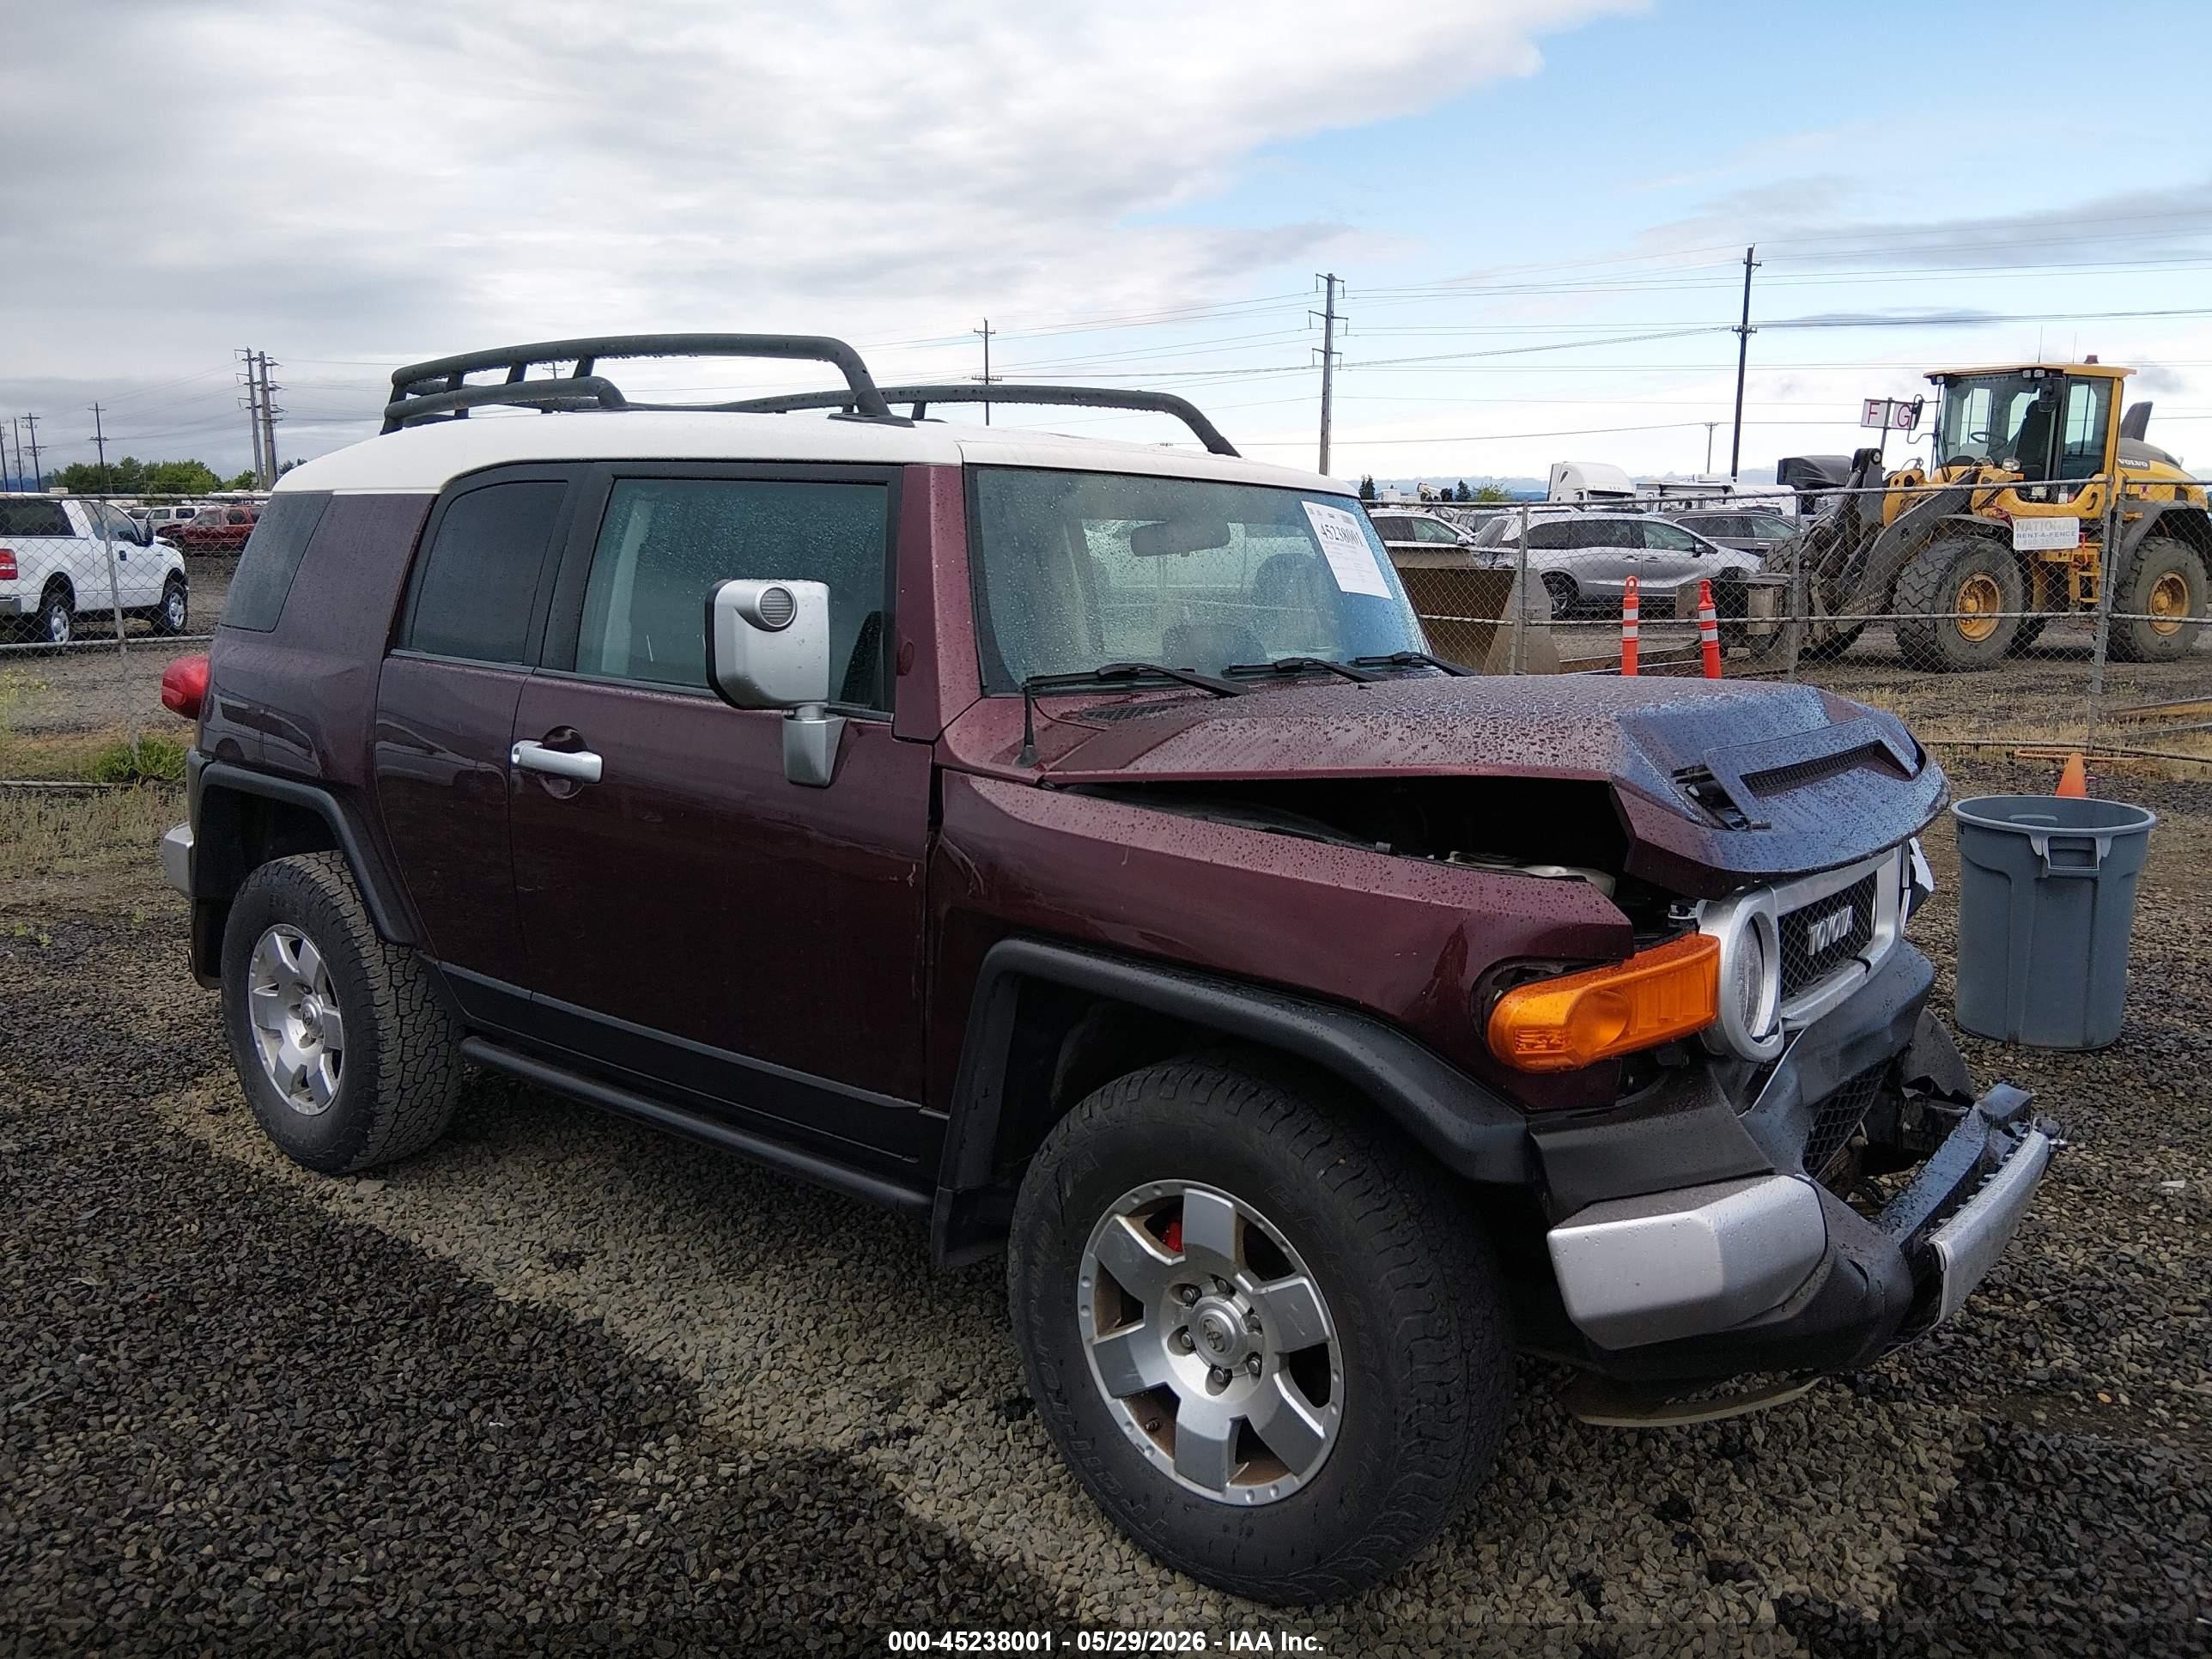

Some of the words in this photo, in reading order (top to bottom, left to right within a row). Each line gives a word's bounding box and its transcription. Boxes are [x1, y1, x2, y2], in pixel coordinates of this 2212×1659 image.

[1867, 402, 1881, 425] F
[1897, 403, 1912, 428] G
[2118, 458, 2148, 467] VOLVO
[1320, 523, 1364, 547] 45238001
[2016, 520, 2076, 532] NATIONAL
[2016, 531, 2076, 539] RENT-A-FENCE
[1808, 905, 1854, 957] TOYOTA
